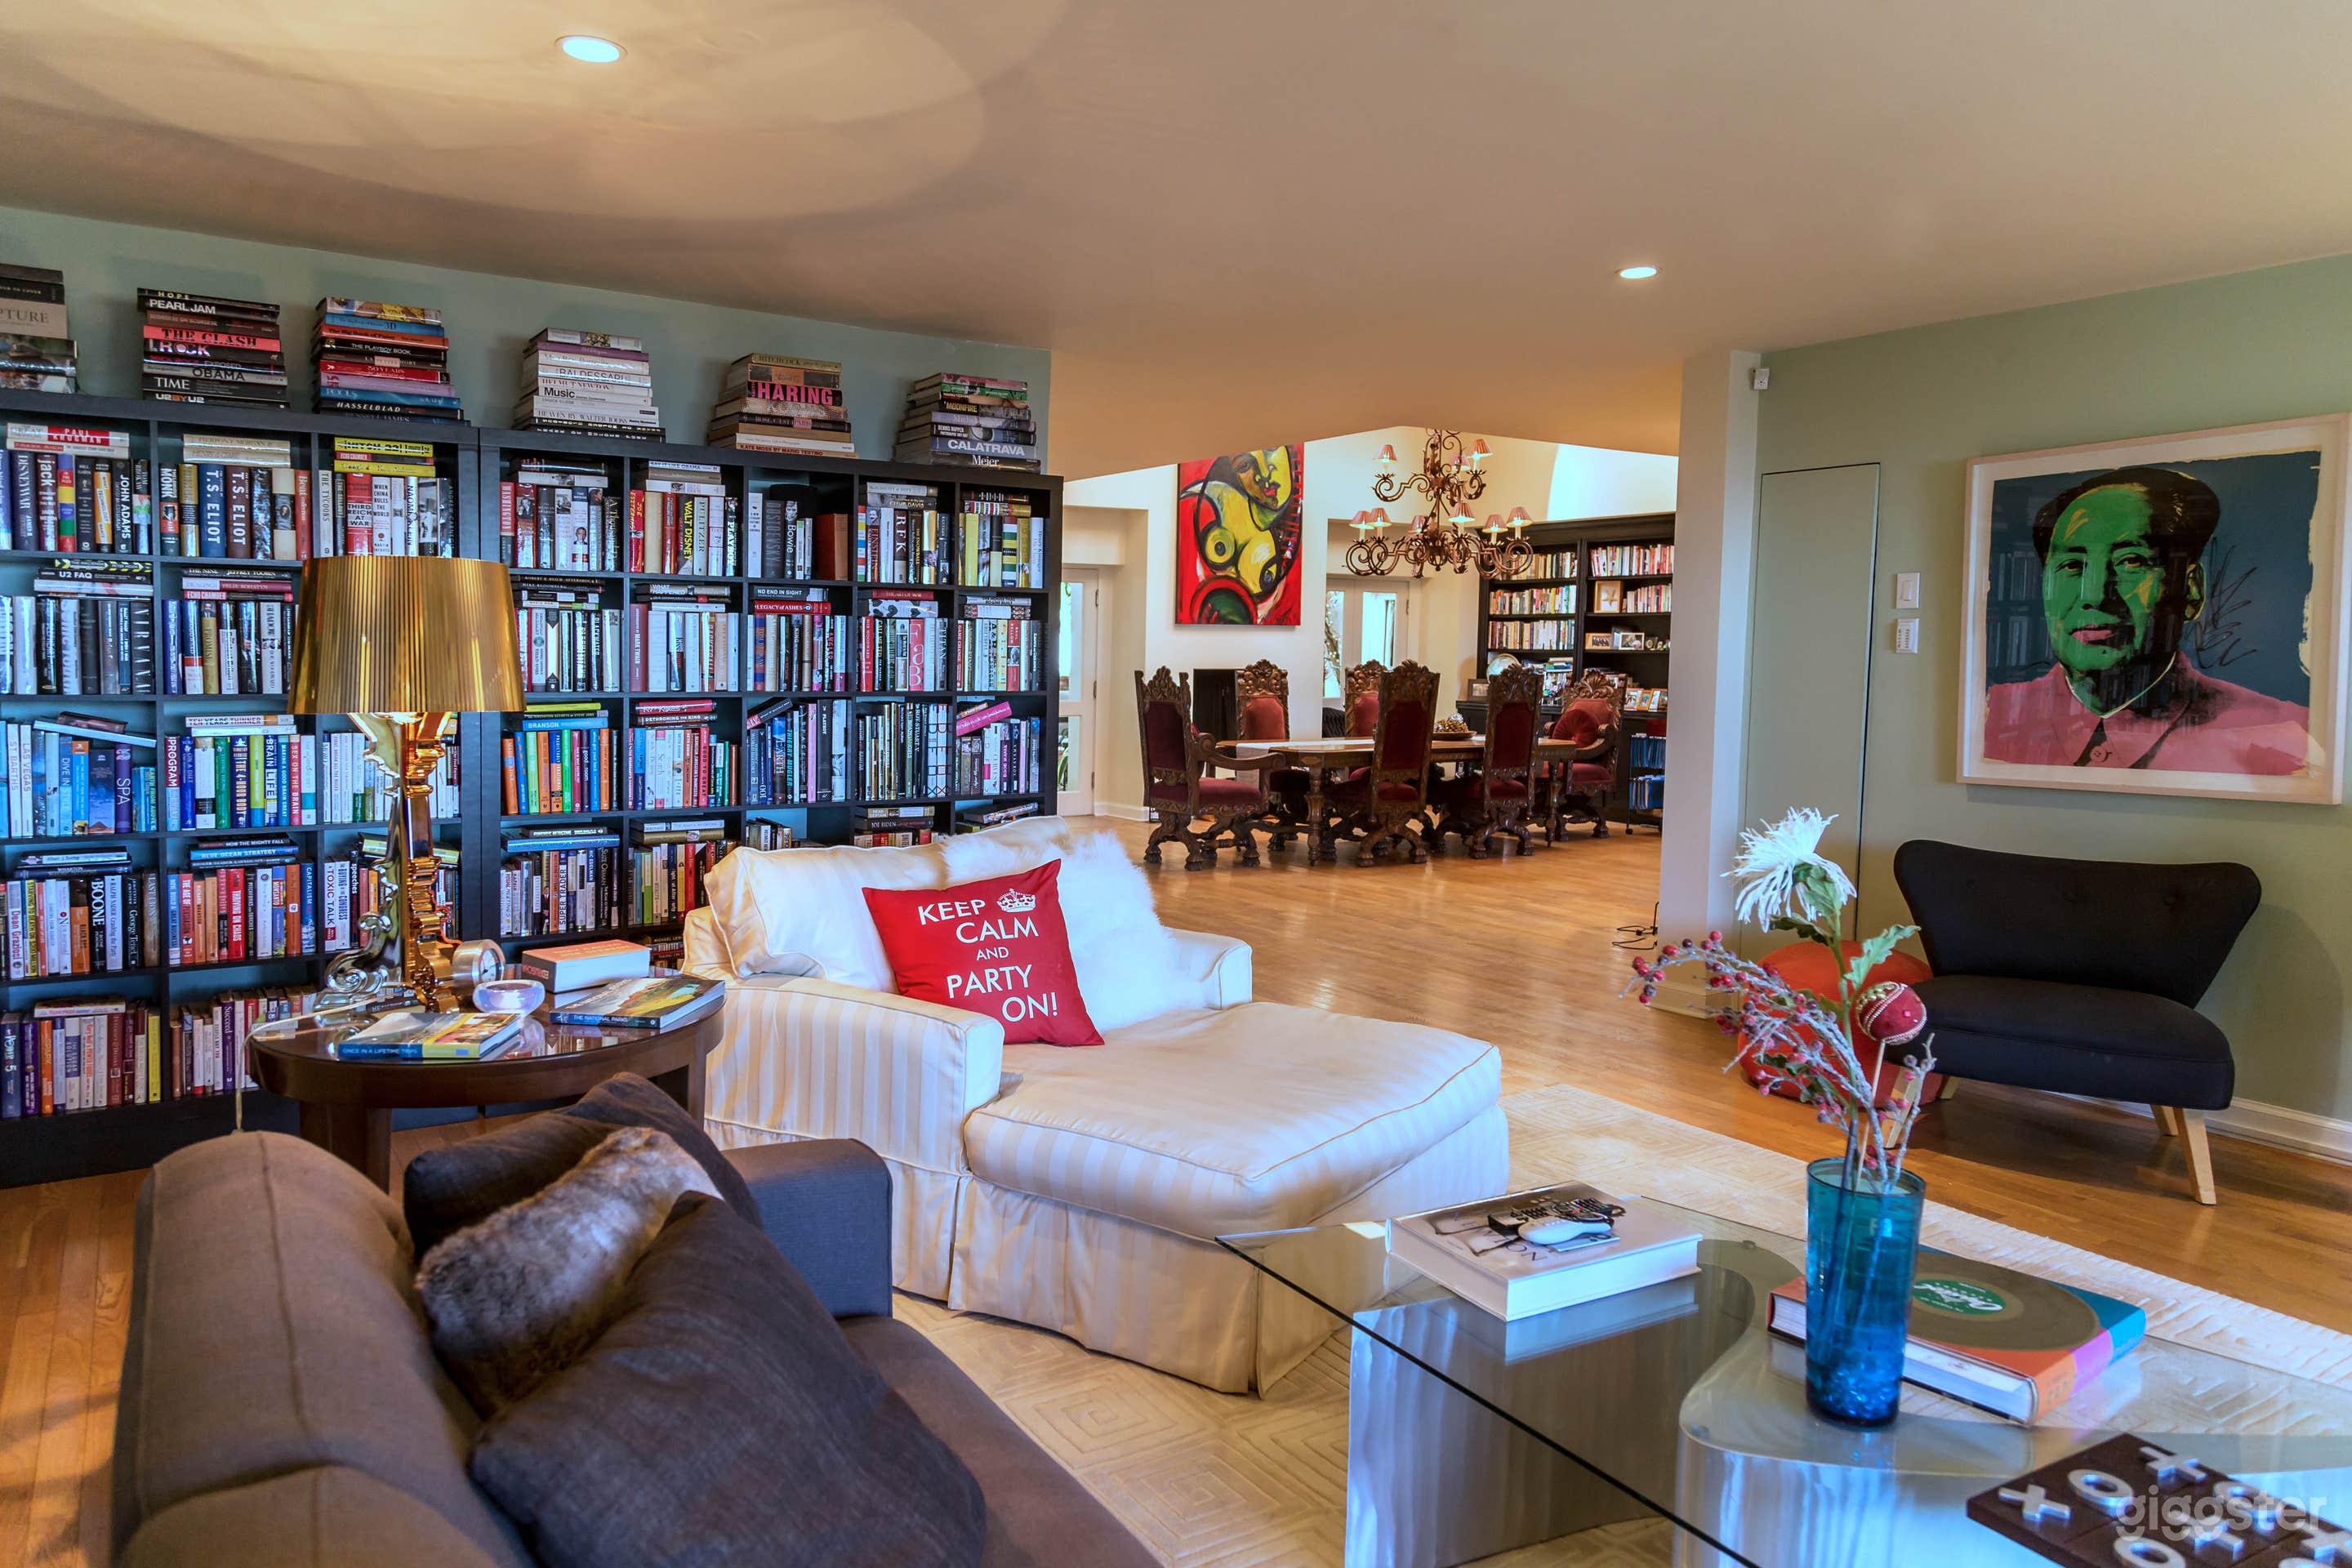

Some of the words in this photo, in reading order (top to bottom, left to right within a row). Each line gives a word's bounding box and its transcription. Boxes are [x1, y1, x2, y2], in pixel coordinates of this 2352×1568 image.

[149, 299, 189, 312] PEARL
[190, 303, 216, 314] JAM
[158, 291, 189, 301] HOPE
[162, 328, 195, 342] THE
[202, 332, 257, 347] CLASH
[364, 345, 392, 354] PLAYBOY
[155, 376, 190, 390] TIME
[192, 368, 245, 381] OBAMA
[542, 379, 576, 388] HELMUT
[577, 381, 610, 390] NEWTON
[559, 368, 625, 382] BALDESSARI
[544, 387, 575, 399] Music
[758, 381, 833, 406] HARING
[336, 402, 400, 412] HASSELBLAD
[52, 435, 103, 443] KRUGMAN
[65, 428, 90, 436] PAUL
[947, 439, 1026, 457] CALATRAVA
[970, 453, 1000, 467] Meier
[18, 455, 31, 509] DISNEYWAR
[38, 458, 56, 487] jack
[160, 468, 172, 497] MONK
[206, 470, 220, 497] T.S.
[321, 473, 329, 486] THE
[120, 474, 129, 499] JOHN
[232, 472, 245, 499] T.S.
[322, 490, 330, 522] TYCOONS
[501, 486, 512, 529] WASHINGTON
[684, 501, 693, 527] WALT
[121, 503, 131, 539] ADAMS
[207, 503, 220, 543] ELIOT
[232, 505, 246, 545] ELIOT
[766, 502, 781, 561] DOSTOEVSKY
[684, 528, 693, 561] DISNEY
[727, 521, 735, 566] PLAYBOY
[786, 524, 796, 554] Bowie
[10, 742, 17, 751] ST
[265, 738, 274, 767] BRAIN
[776, 739, 784, 774] EARTH
[11, 756, 19, 791] BARTHS
[62, 757, 70, 775] DIVE
[168, 737, 178, 786] PROGRAM
[236, 761, 247, 772] THE
[292, 763, 298, 772] ON
[117, 777, 131, 805] SPA
[236, 773, 247, 797] 4-HOUR
[267, 771, 275, 796] LIFE
[236, 799, 247, 814] BODY
[327, 870, 335, 898] TOXIC
[338, 868, 347, 886] BUYING
[350, 864, 359, 894] speeches
[91, 880, 105, 926] BOONE
[232, 890, 241, 915] THRIVING
[338, 895, 348, 920] CONGRESS
[918, 899, 986, 925] KEEP
[11, 911, 20, 932] Dean
[128, 909, 137, 932] George
[327, 903, 335, 928] TALK
[233, 925, 242, 942] CHAOS
[956, 916, 1040, 944] CALM
[12, 932, 21, 960] Graziosi
[129, 933, 137, 956] Tenet
[976, 947, 1009, 961] AND
[946, 964, 1033, 999] PARTY
[1001, 991, 1058, 1022] ON!
[225, 1006, 233, 1033] Succeed
